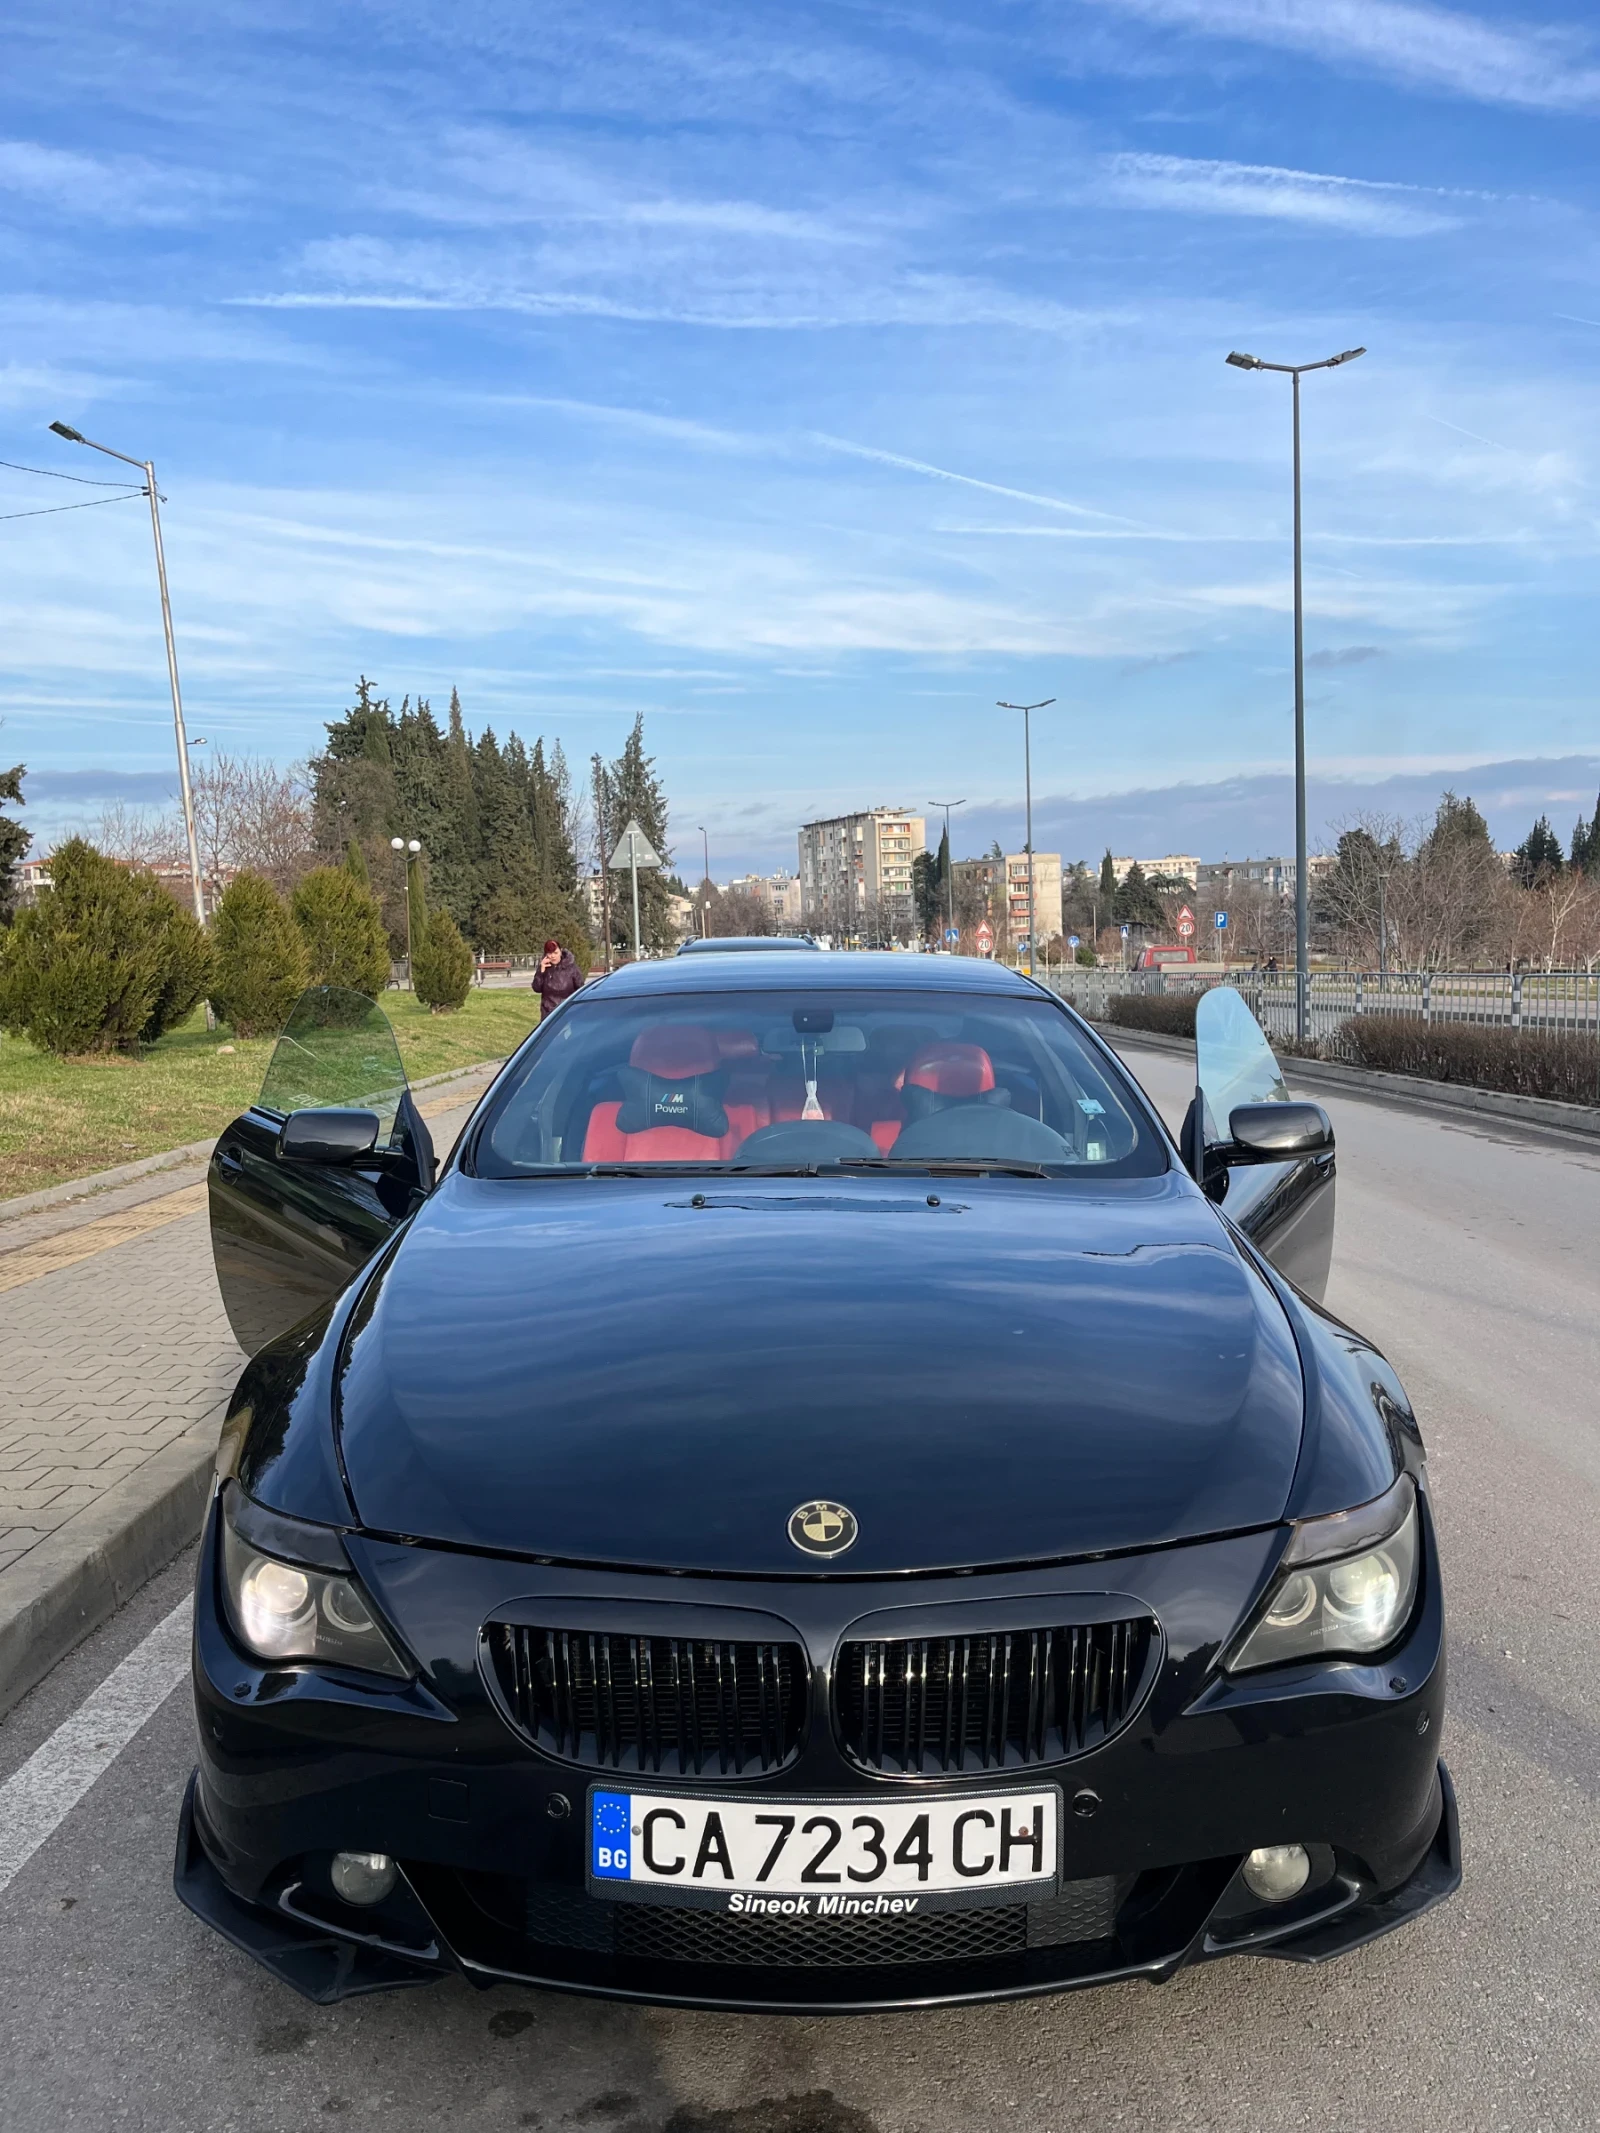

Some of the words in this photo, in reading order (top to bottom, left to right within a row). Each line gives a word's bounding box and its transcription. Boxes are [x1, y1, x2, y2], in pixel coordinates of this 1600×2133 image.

[1217, 913, 1225, 927] P
[1180, 924, 1191, 933] 20
[980, 939, 990, 949] 20
[655, 1103, 688, 1114] Power
[797, 1504, 849, 1519] BMW
[643, 1808, 734, 1880] CA
[755, 1813, 933, 1883] 7234
[953, 1805, 1044, 1877] CH
[598, 1847, 627, 1869] BG
[728, 1893, 811, 1914] Sineok
[817, 1895, 918, 1914] Minchev
